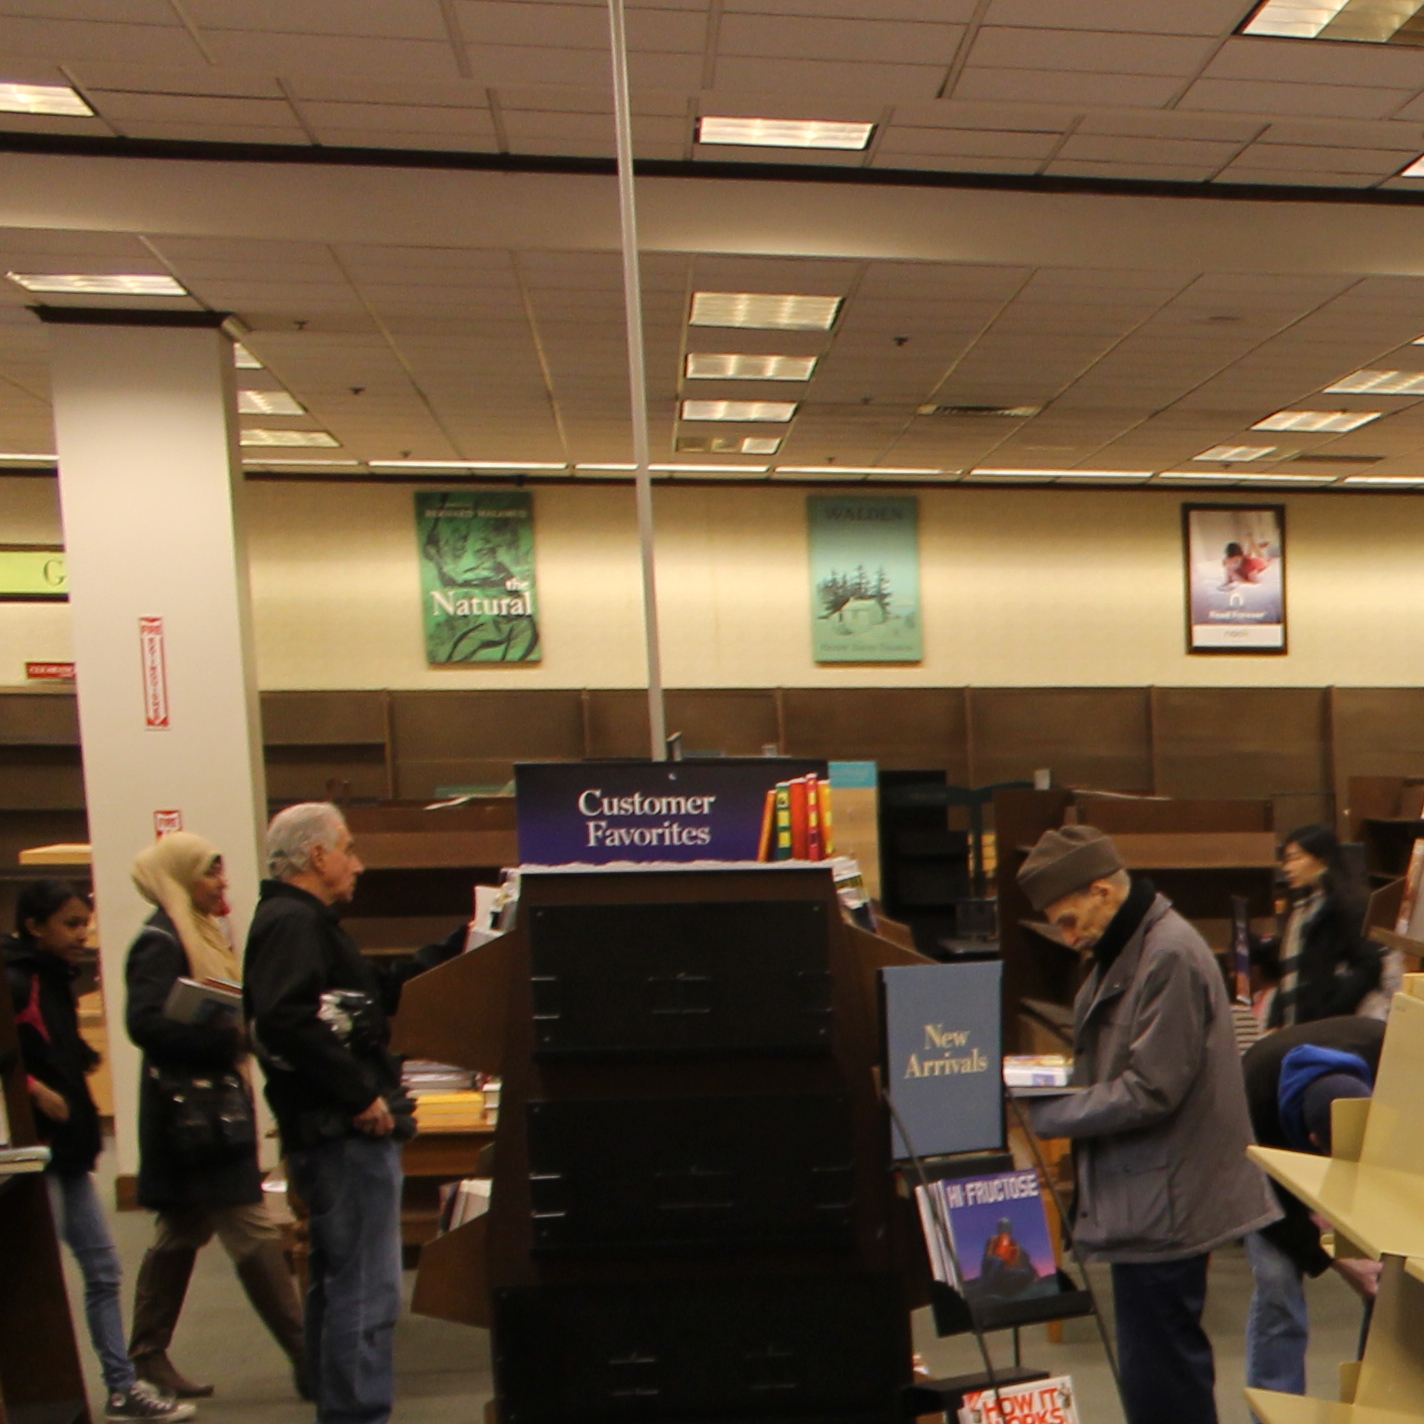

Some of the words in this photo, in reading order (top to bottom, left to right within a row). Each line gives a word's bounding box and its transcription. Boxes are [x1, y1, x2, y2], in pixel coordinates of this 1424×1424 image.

[505, 577, 529, 591] the
[430, 590, 532, 616] Natural
[578, 789, 716, 817] Customer
[586, 820, 711, 847] Favorites
[924, 1024, 970, 1050] New
[904, 1048, 989, 1080] Arrivals
[945, 1174, 1040, 1208] HI-FRUCTOSE
[983, 1392, 1033, 1419] HOW
[1039, 1388, 1058, 1409] IT
